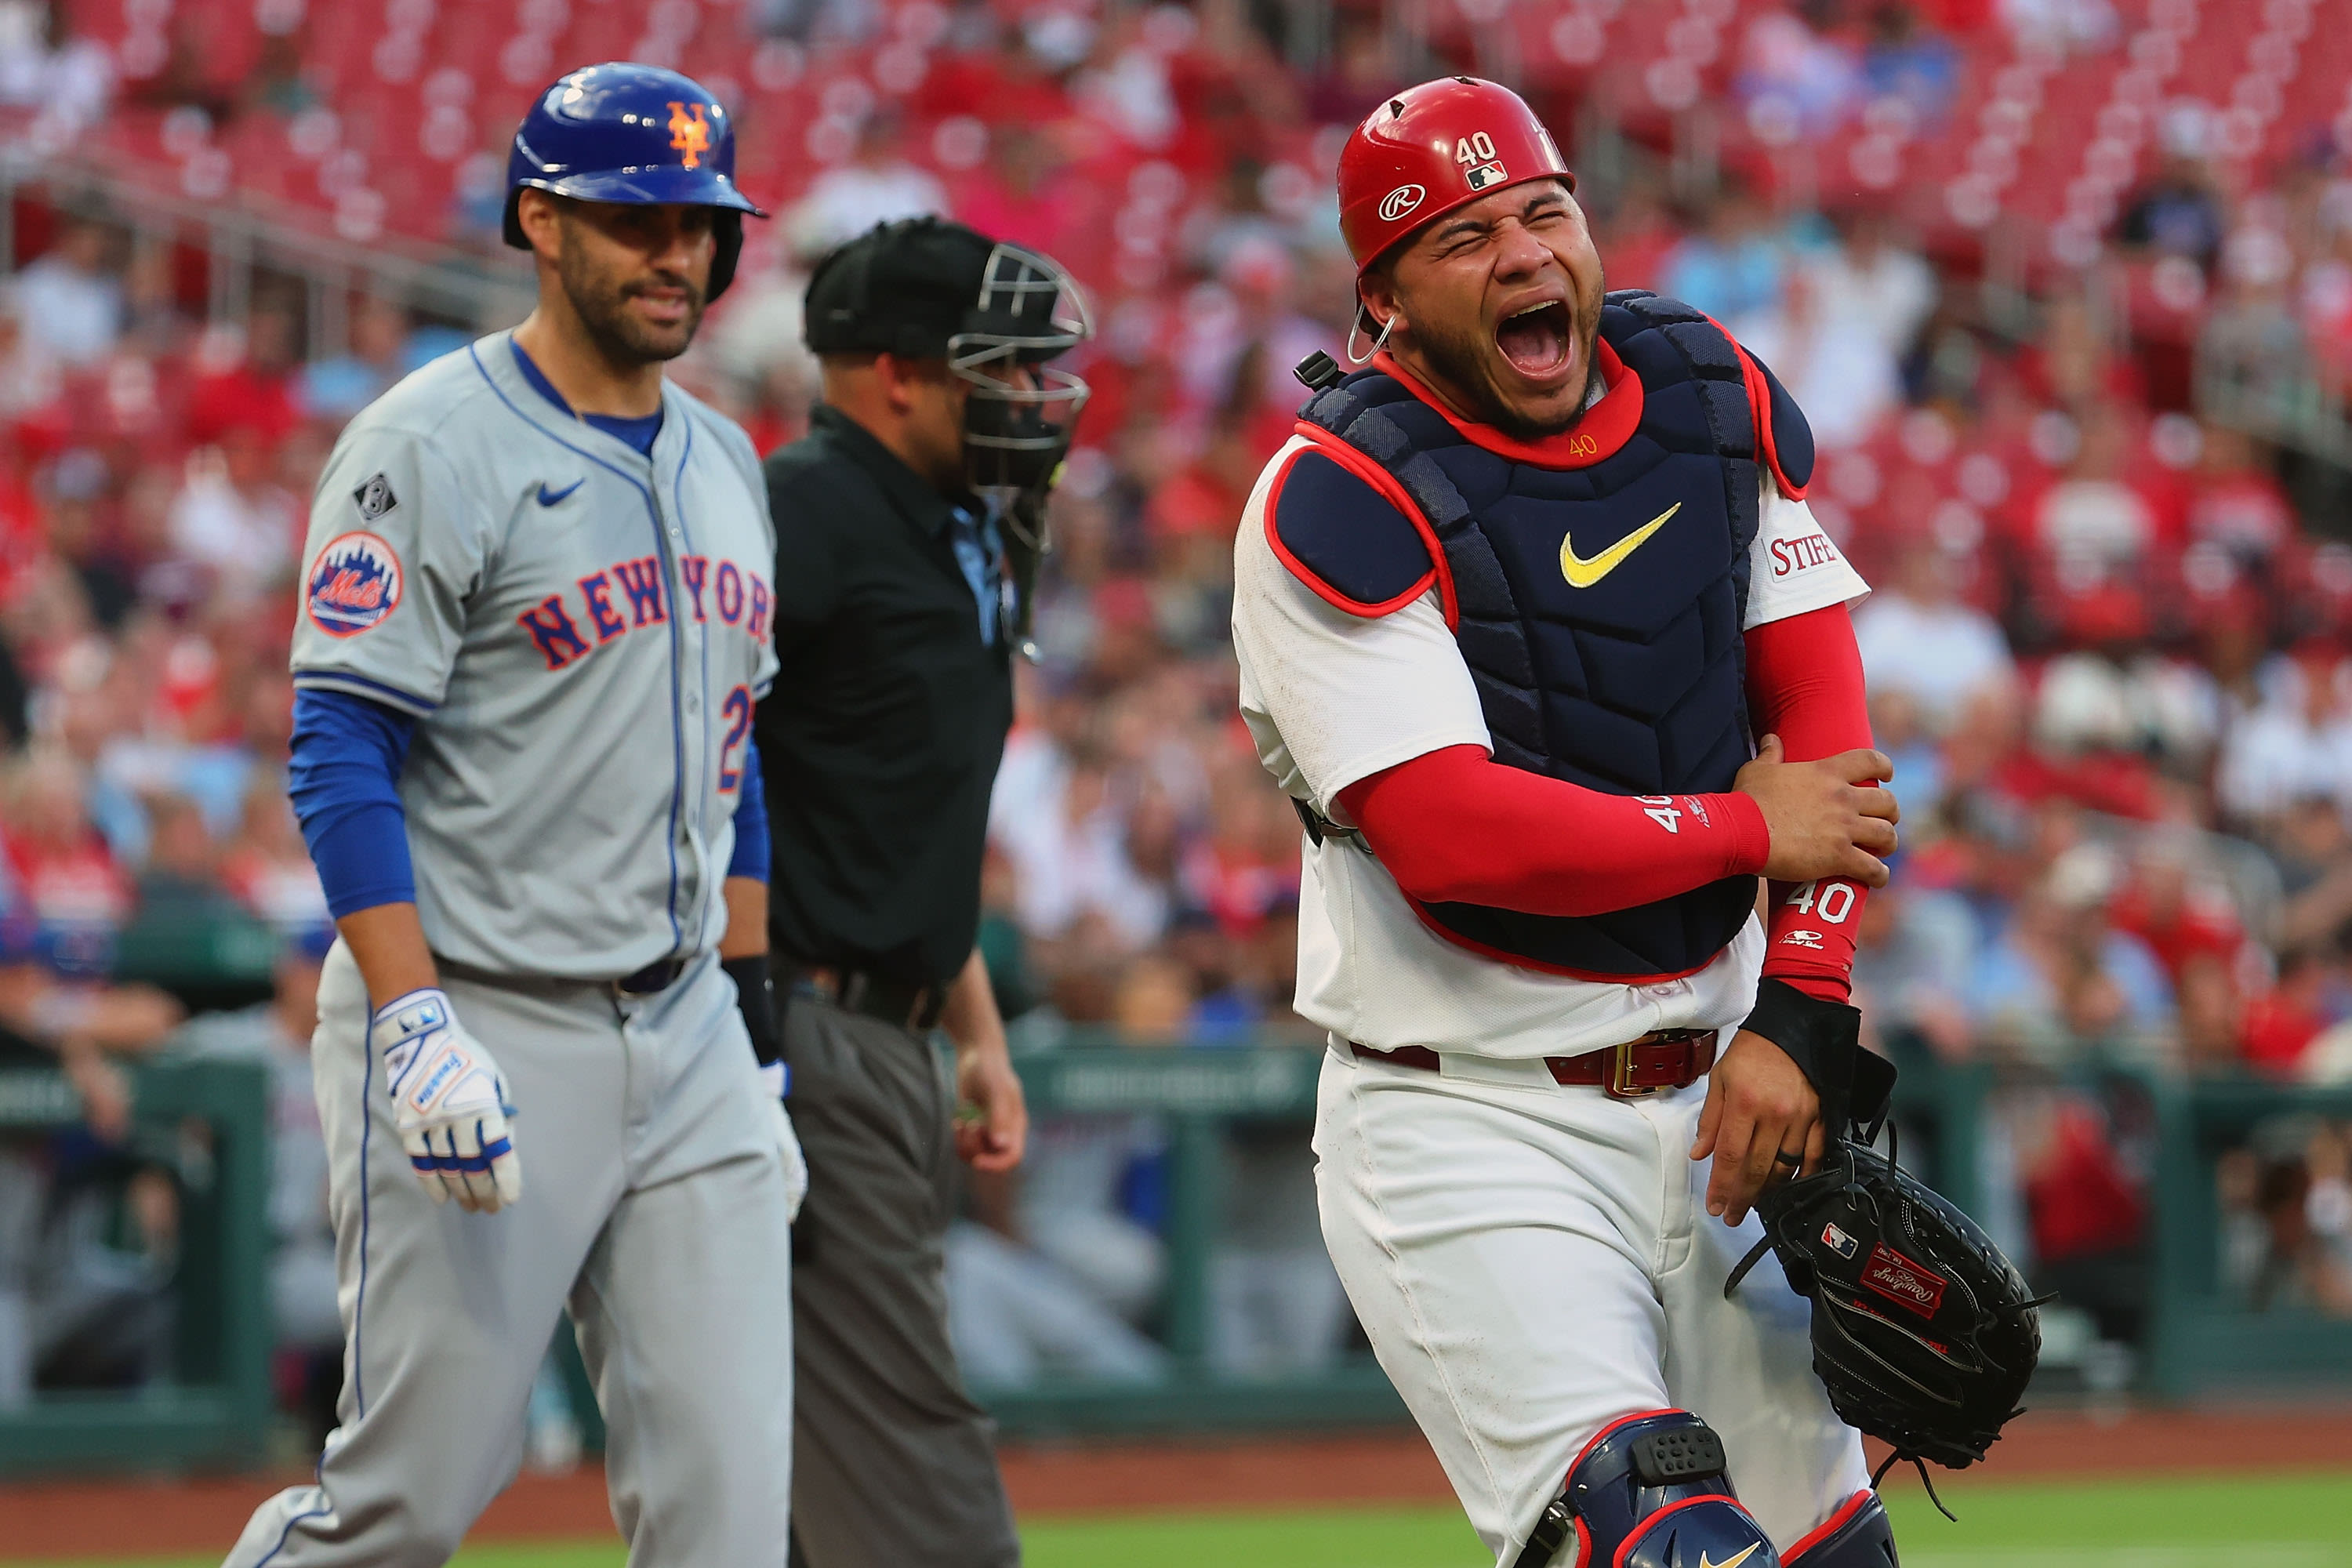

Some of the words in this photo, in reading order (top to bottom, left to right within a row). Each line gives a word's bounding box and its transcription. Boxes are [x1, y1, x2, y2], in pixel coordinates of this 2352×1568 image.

[667, 101, 710, 167] NY
[1456, 131, 1497, 166] 40
[1569, 434, 1598, 459] 40
[317, 568, 382, 609] Mets
[517, 554, 668, 672] NEW
[678, 554, 776, 645] YOR
[719, 684, 755, 793] 2
[1786, 880, 1855, 924] 40
[1872, 1267, 1934, 1301] Rawlings
